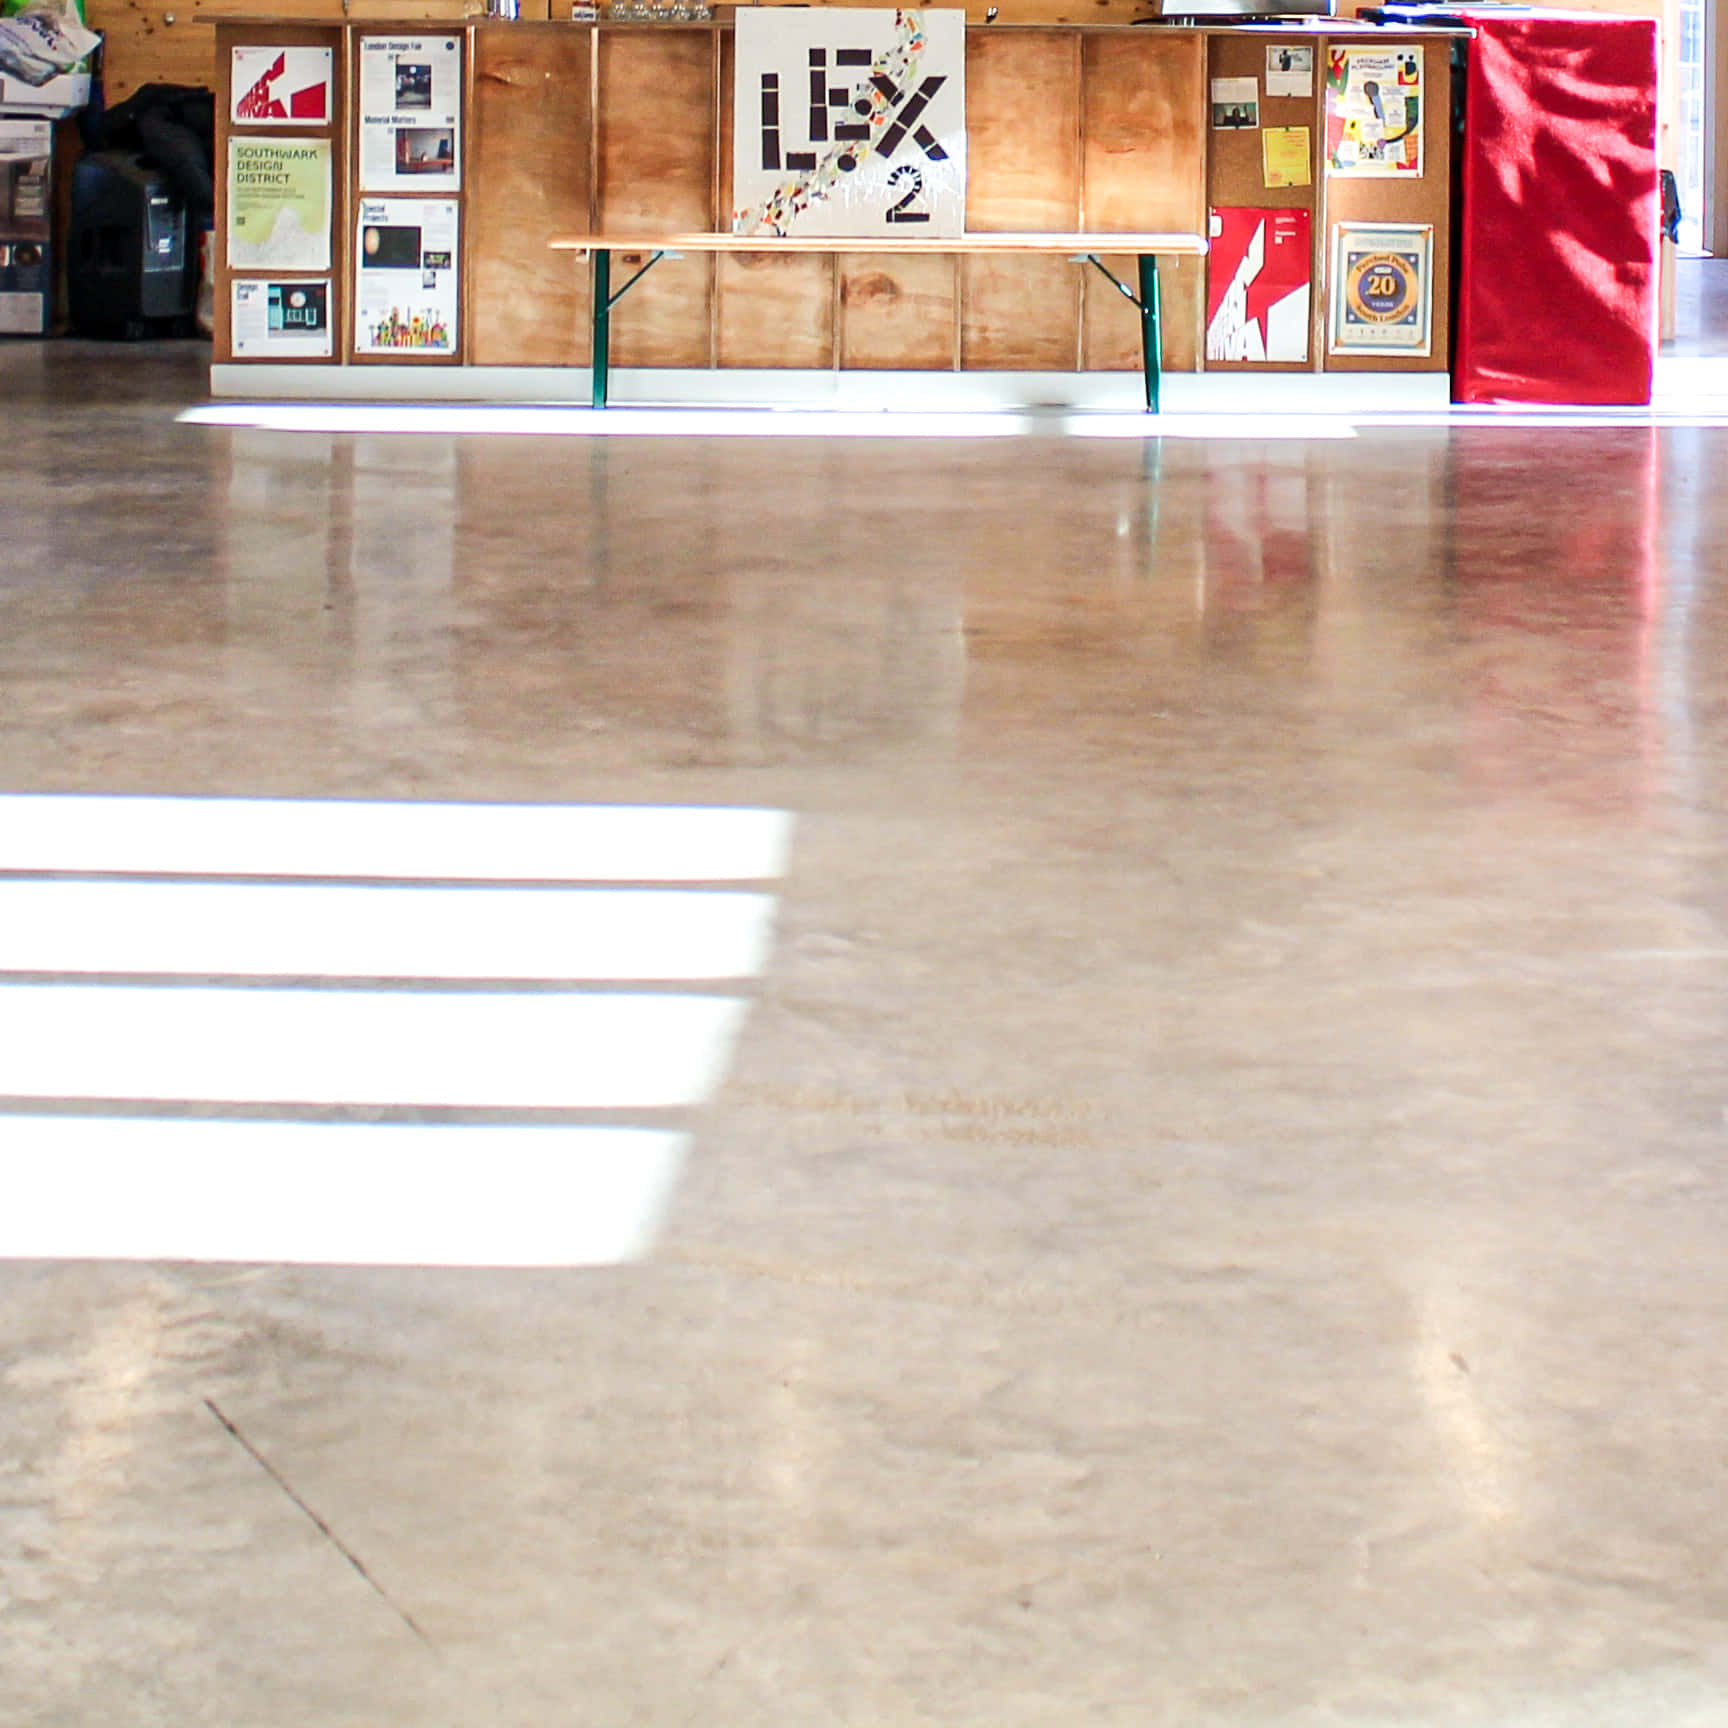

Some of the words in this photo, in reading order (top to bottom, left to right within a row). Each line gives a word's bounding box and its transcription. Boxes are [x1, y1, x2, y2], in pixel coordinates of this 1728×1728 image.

[761, 48, 949, 170] LEX
[236, 147, 318, 160] SOUTHWARK
[236, 160, 283, 171] DESIGN
[236, 173, 290, 184] DISTRICT
[886, 165, 930, 223] 2
[1368, 275, 1398, 296] 20
